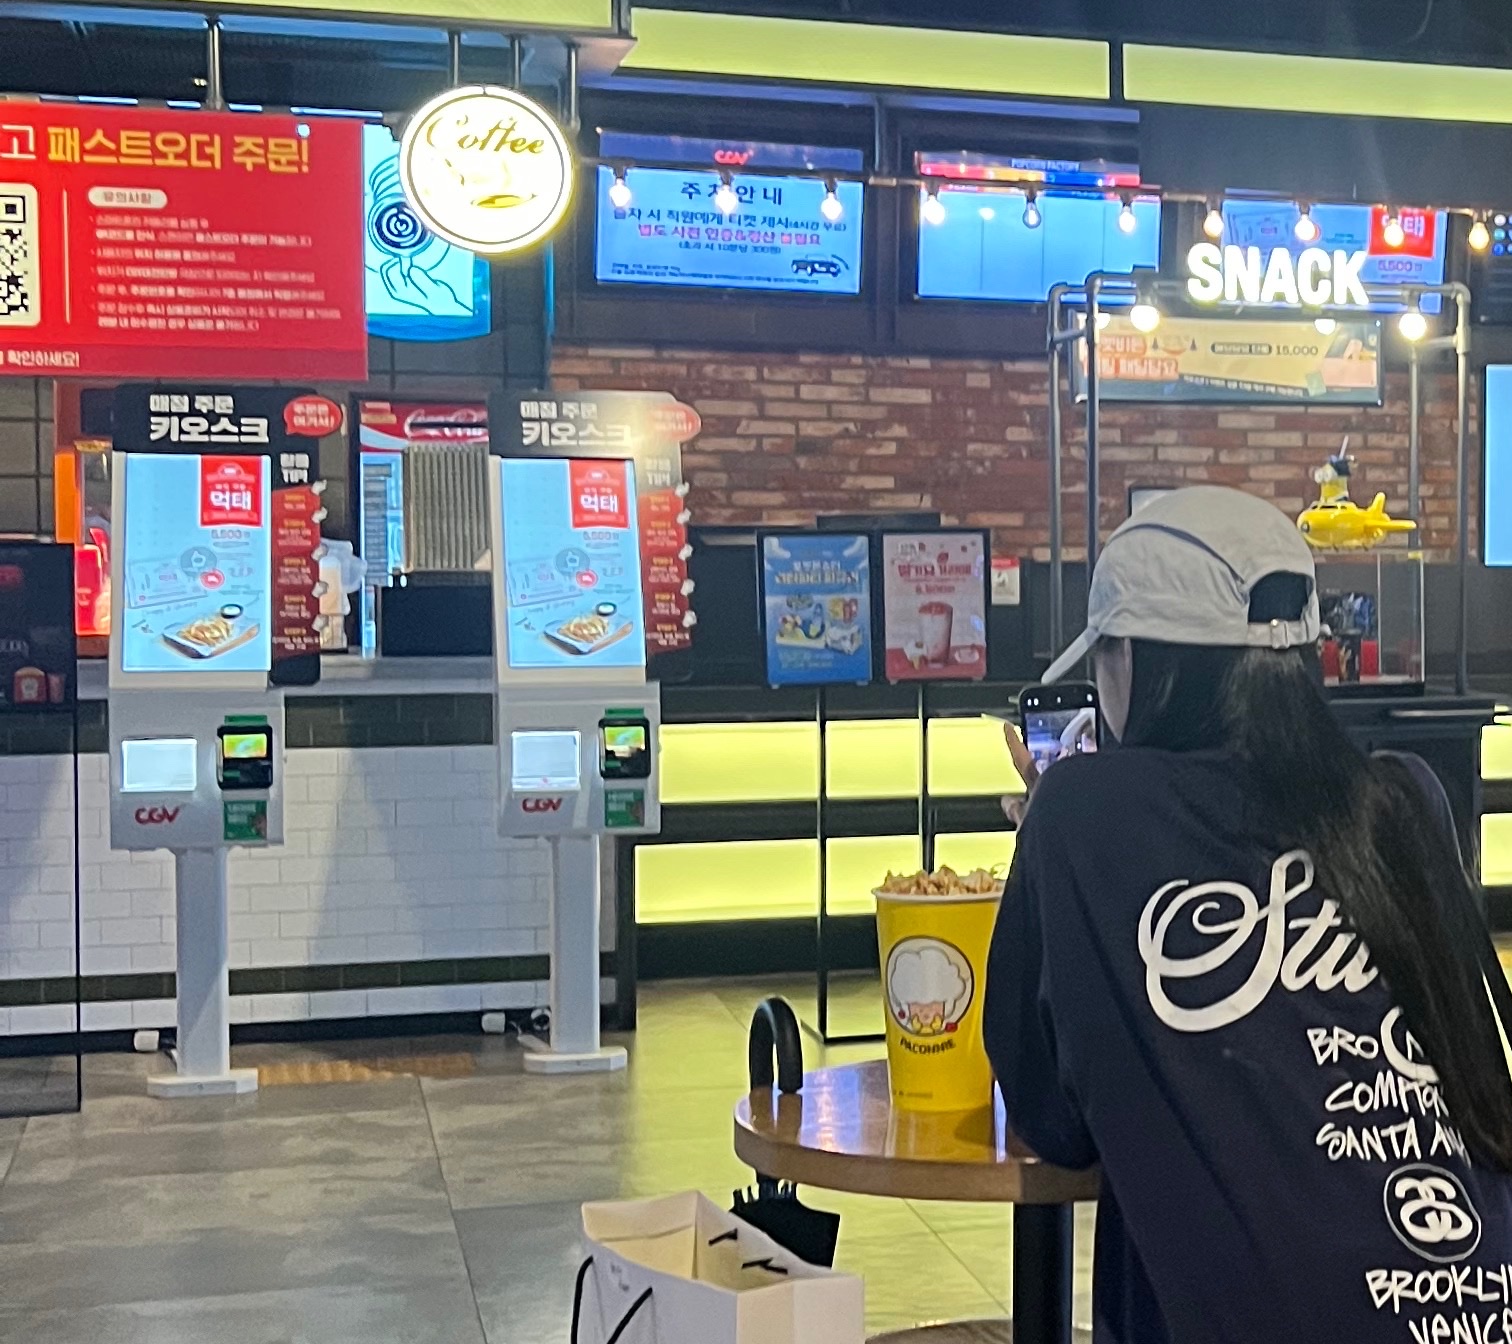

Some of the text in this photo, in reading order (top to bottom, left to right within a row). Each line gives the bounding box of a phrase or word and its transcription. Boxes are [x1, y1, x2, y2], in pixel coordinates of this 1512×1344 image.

[48, 126, 222, 170] 패스트오더
[233, 133, 309, 174] 주문!
[427, 115, 544, 153] Coffee
[1187, 243, 1370, 305] SNACK
[194, 395, 234, 414] 주문
[150, 416, 269, 444] 키오스크
[522, 421, 632, 447] 키오스크
[135, 806, 180, 824] CGV
[522, 797, 563, 813] CGV
[1138, 849, 1379, 1033] Stu
[1316, 1117, 1472, 1169] SANTA AN
